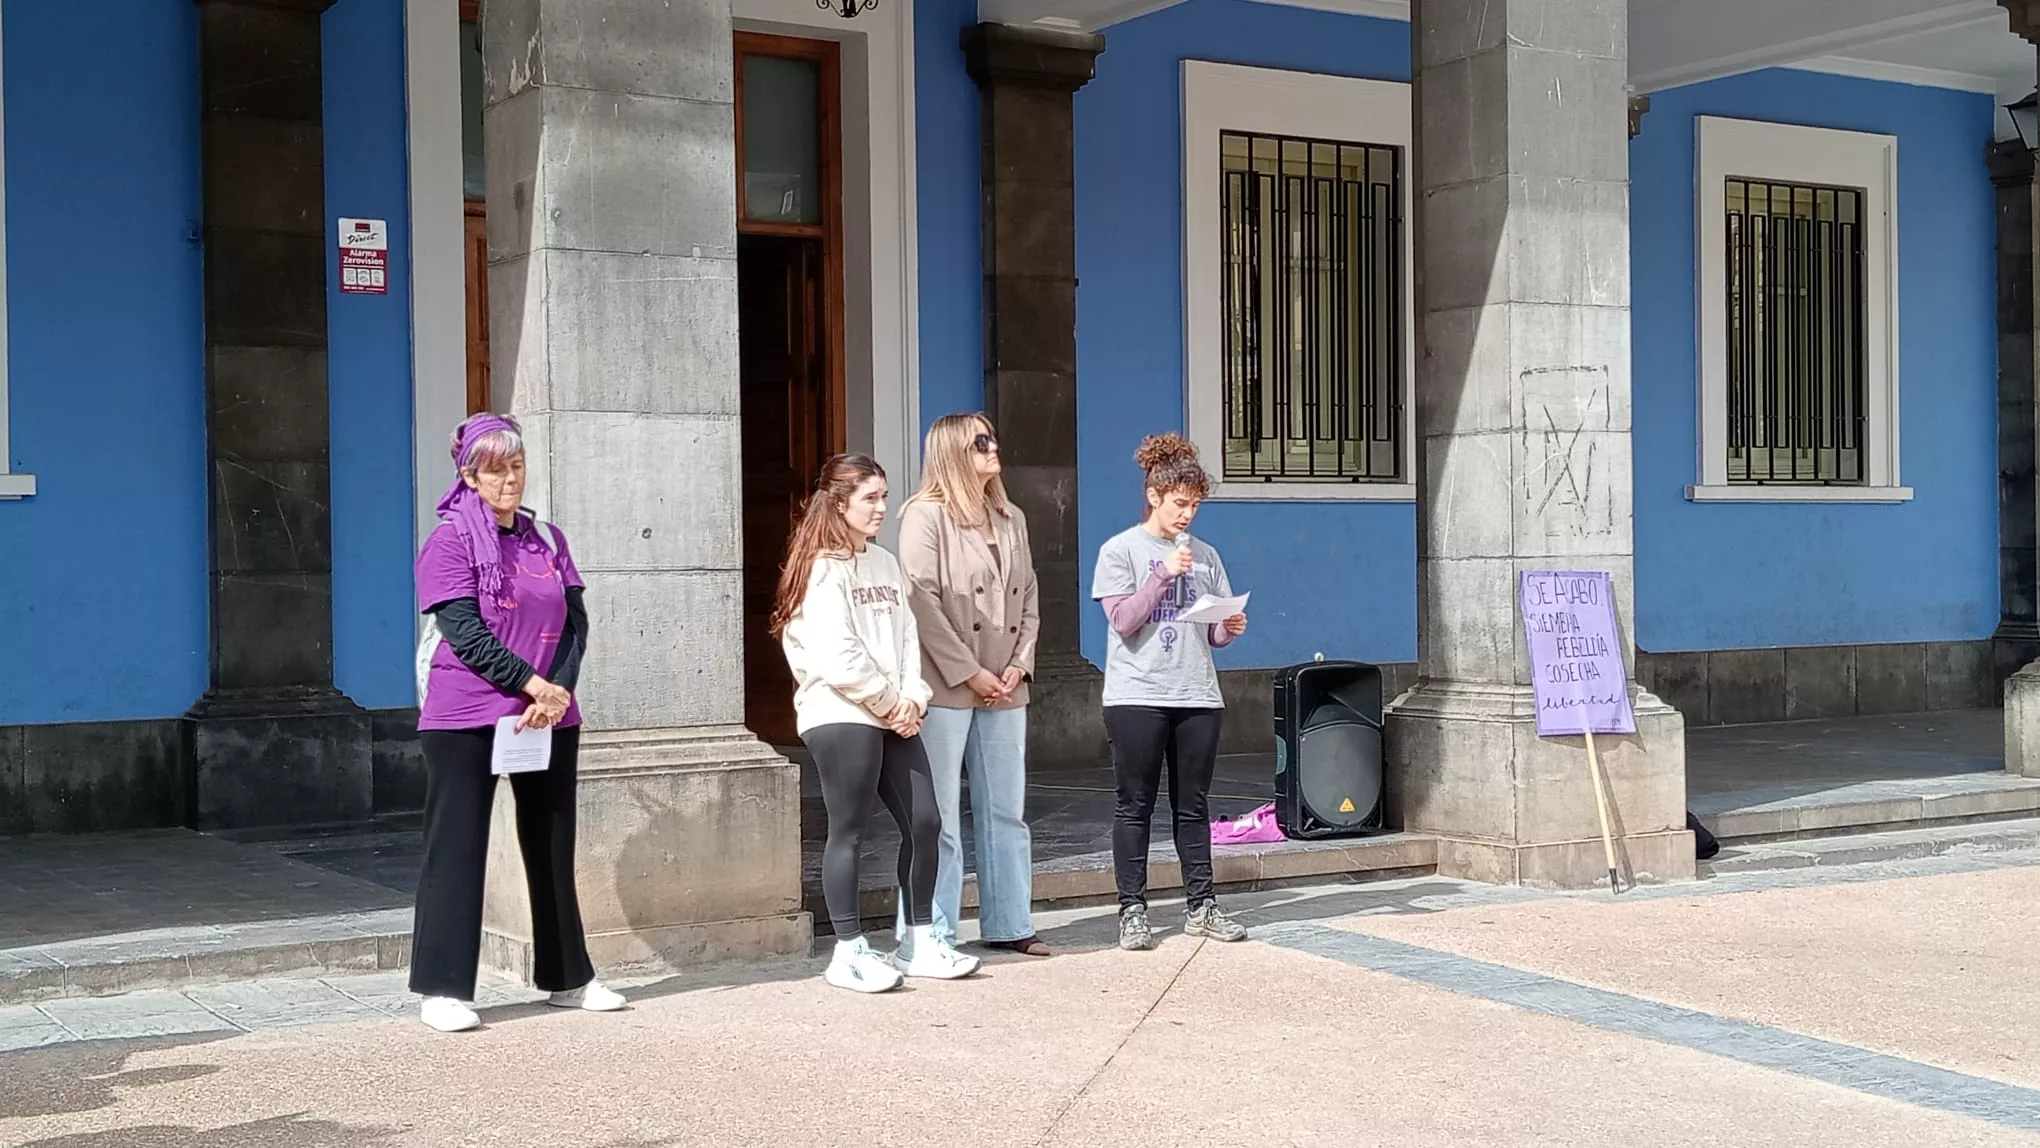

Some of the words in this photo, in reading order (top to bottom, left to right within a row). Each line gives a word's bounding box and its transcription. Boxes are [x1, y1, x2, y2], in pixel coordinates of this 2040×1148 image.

[343, 256, 384, 265] Zerovision
[350, 249, 377, 257] Alarma
[1526, 574, 1552, 606] SE
[1530, 612, 1581, 633] SIEMBRA
[1545, 661, 1600, 683] COSECHA
[1543, 693, 1619, 711] libertad
